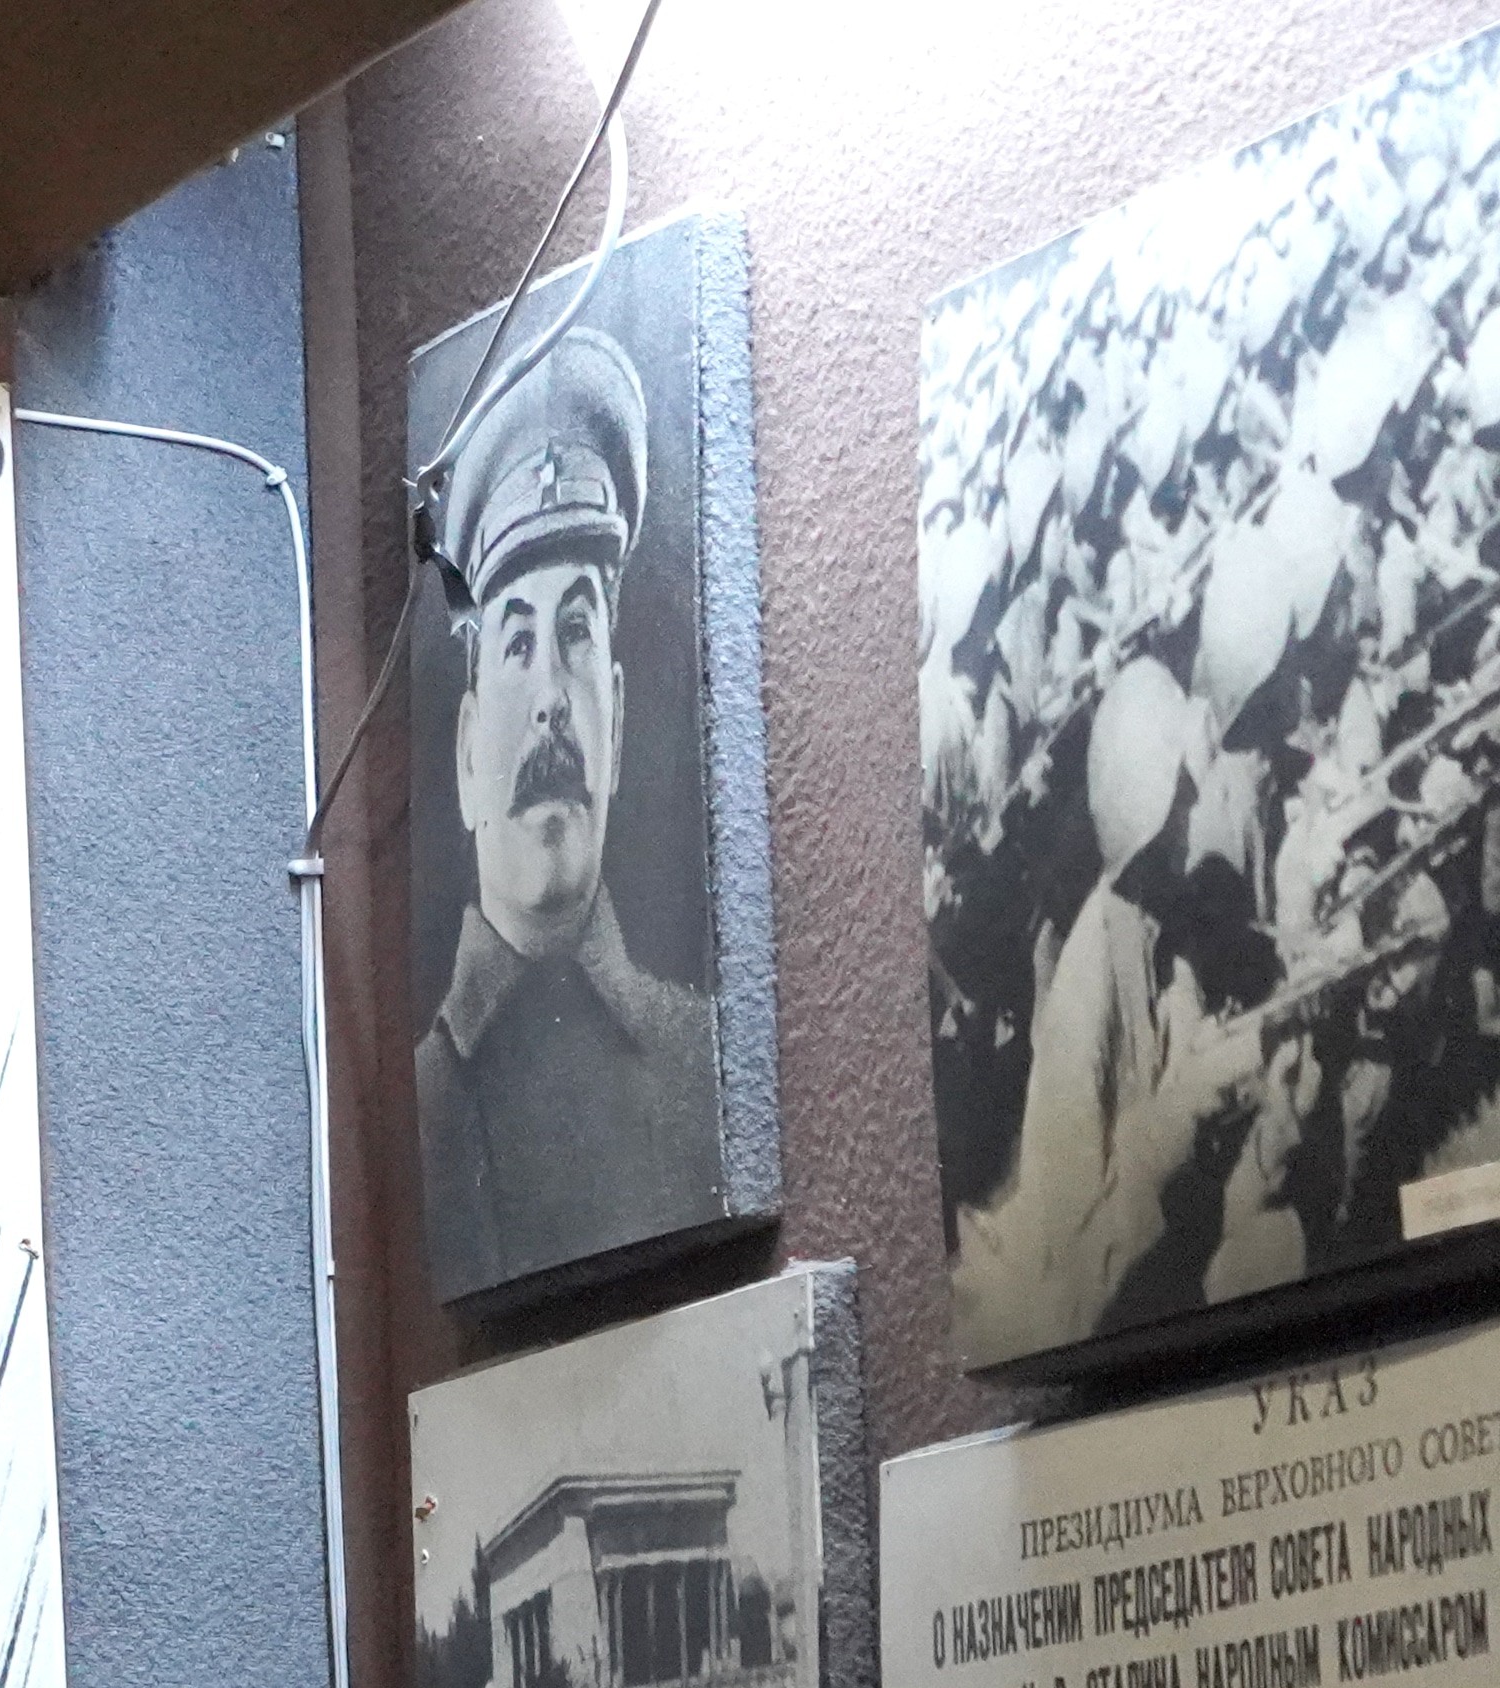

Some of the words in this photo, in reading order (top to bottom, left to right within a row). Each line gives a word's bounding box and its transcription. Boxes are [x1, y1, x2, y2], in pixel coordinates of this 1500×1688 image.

[1252, 1355, 1379, 1435] УКАЗ
[1020, 1486, 1203, 1560] ПРЕЗИДИУМА
[1220, 1436, 1403, 1517] ВЕРХОВНОГО
[933, 1609, 946, 1669] О
[953, 1582, 1083, 1665] НАЗНАЧЕНИИ
[1094, 1541, 1257, 1639] ПРЕДСЕДАТЕЛЯ
[1270, 1520, 1352, 1600] СОВЕТА
[1367, 1488, 1493, 1578] НАРОДНЫХ
[1337, 1588, 1490, 1682] КОМИССАРОМ
